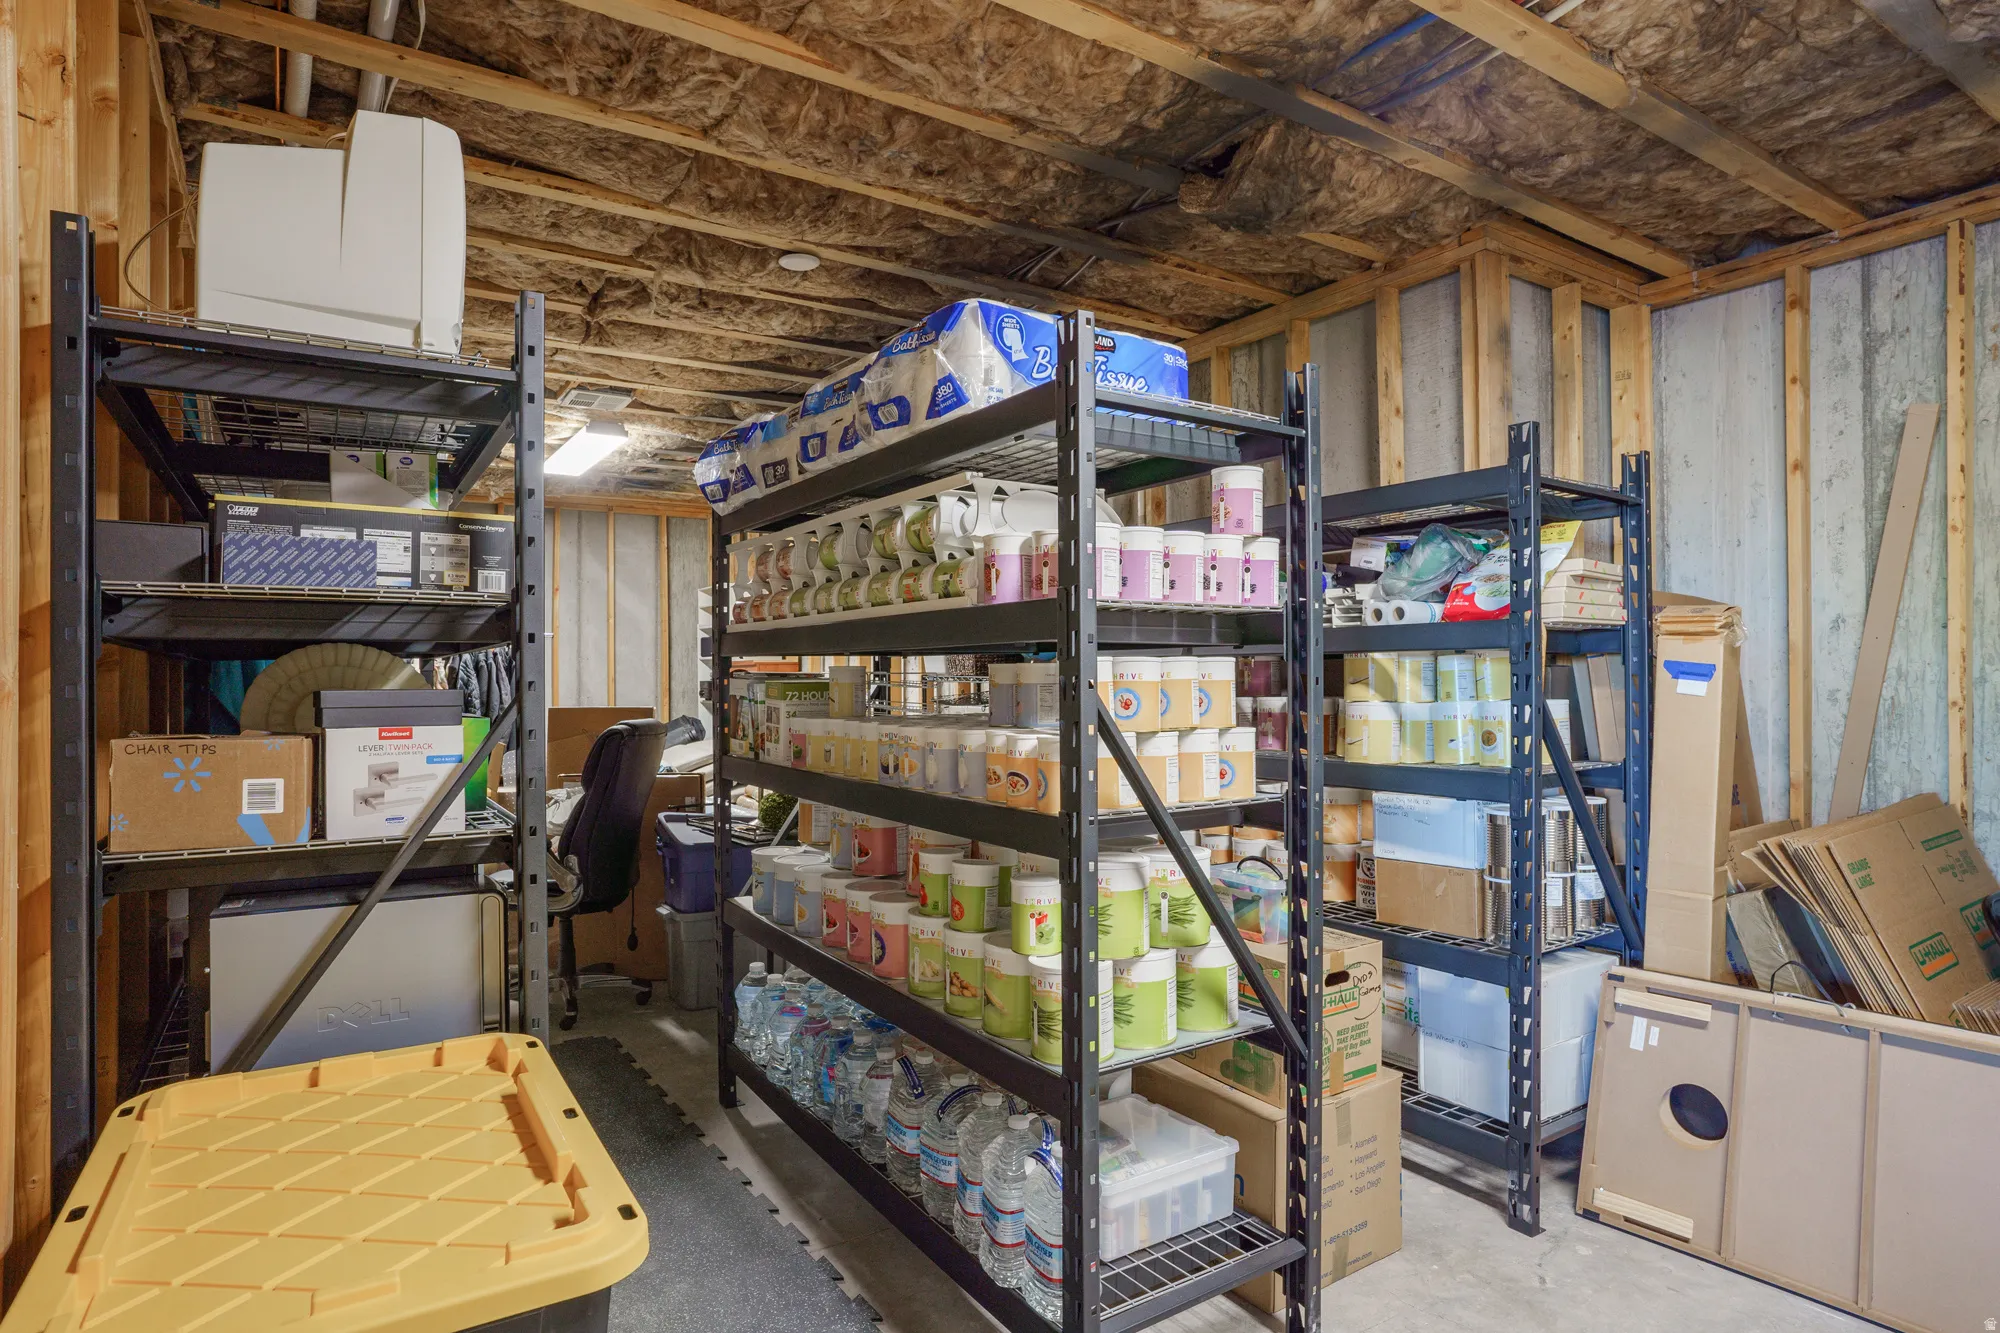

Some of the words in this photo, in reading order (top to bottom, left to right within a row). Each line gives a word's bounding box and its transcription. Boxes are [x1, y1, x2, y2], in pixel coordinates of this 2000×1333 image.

[1001, 322, 1021, 330] SHEETS
[891, 336, 919, 353] Bath
[1163, 353, 1173, 363] 30
[1094, 354, 1149, 392] Tissue
[774, 464, 786, 475] 30
[785, 691, 799, 701] 72
[124, 744, 172, 756] CHAIR
[178, 744, 218, 755] TIPS
[358, 744, 384, 752] LEVER
[1009, 749, 1029, 757] RIVE
[1154, 868, 1182, 878] THRI
[1847, 857, 1872, 876] GRANDE
[1854, 873, 1876, 890] LARGE
[1914, 937, 1951, 967] U-HAUL
[1358, 984, 1382, 997] Games
[316, 997, 410, 1033] DELL
[1336, 1027, 1350, 1037] NEED
[1350, 1021, 1370, 1033] BOXES?
[1421, 1028, 1433, 1037] Red
[1434, 1032, 1456, 1044] Wheat
[1336, 1036, 1350, 1046] TAKE
[1350, 1030, 1369, 1042] PLENTY!
[1349, 1042, 1359, 1051] Buy
[1360, 1037, 1371, 1046] Back
[1345, 1050, 1361, 1060] Extras.
[1354, 1134, 1378, 1150] Alameda
[1354, 1149, 1378, 1165] Hayward
[1354, 1168, 1366, 1181] Los
[1365, 1160, 1386, 1177] Angeles
[1354, 1184, 1366, 1196] San
[1366, 1177, 1382, 1191] Diego
